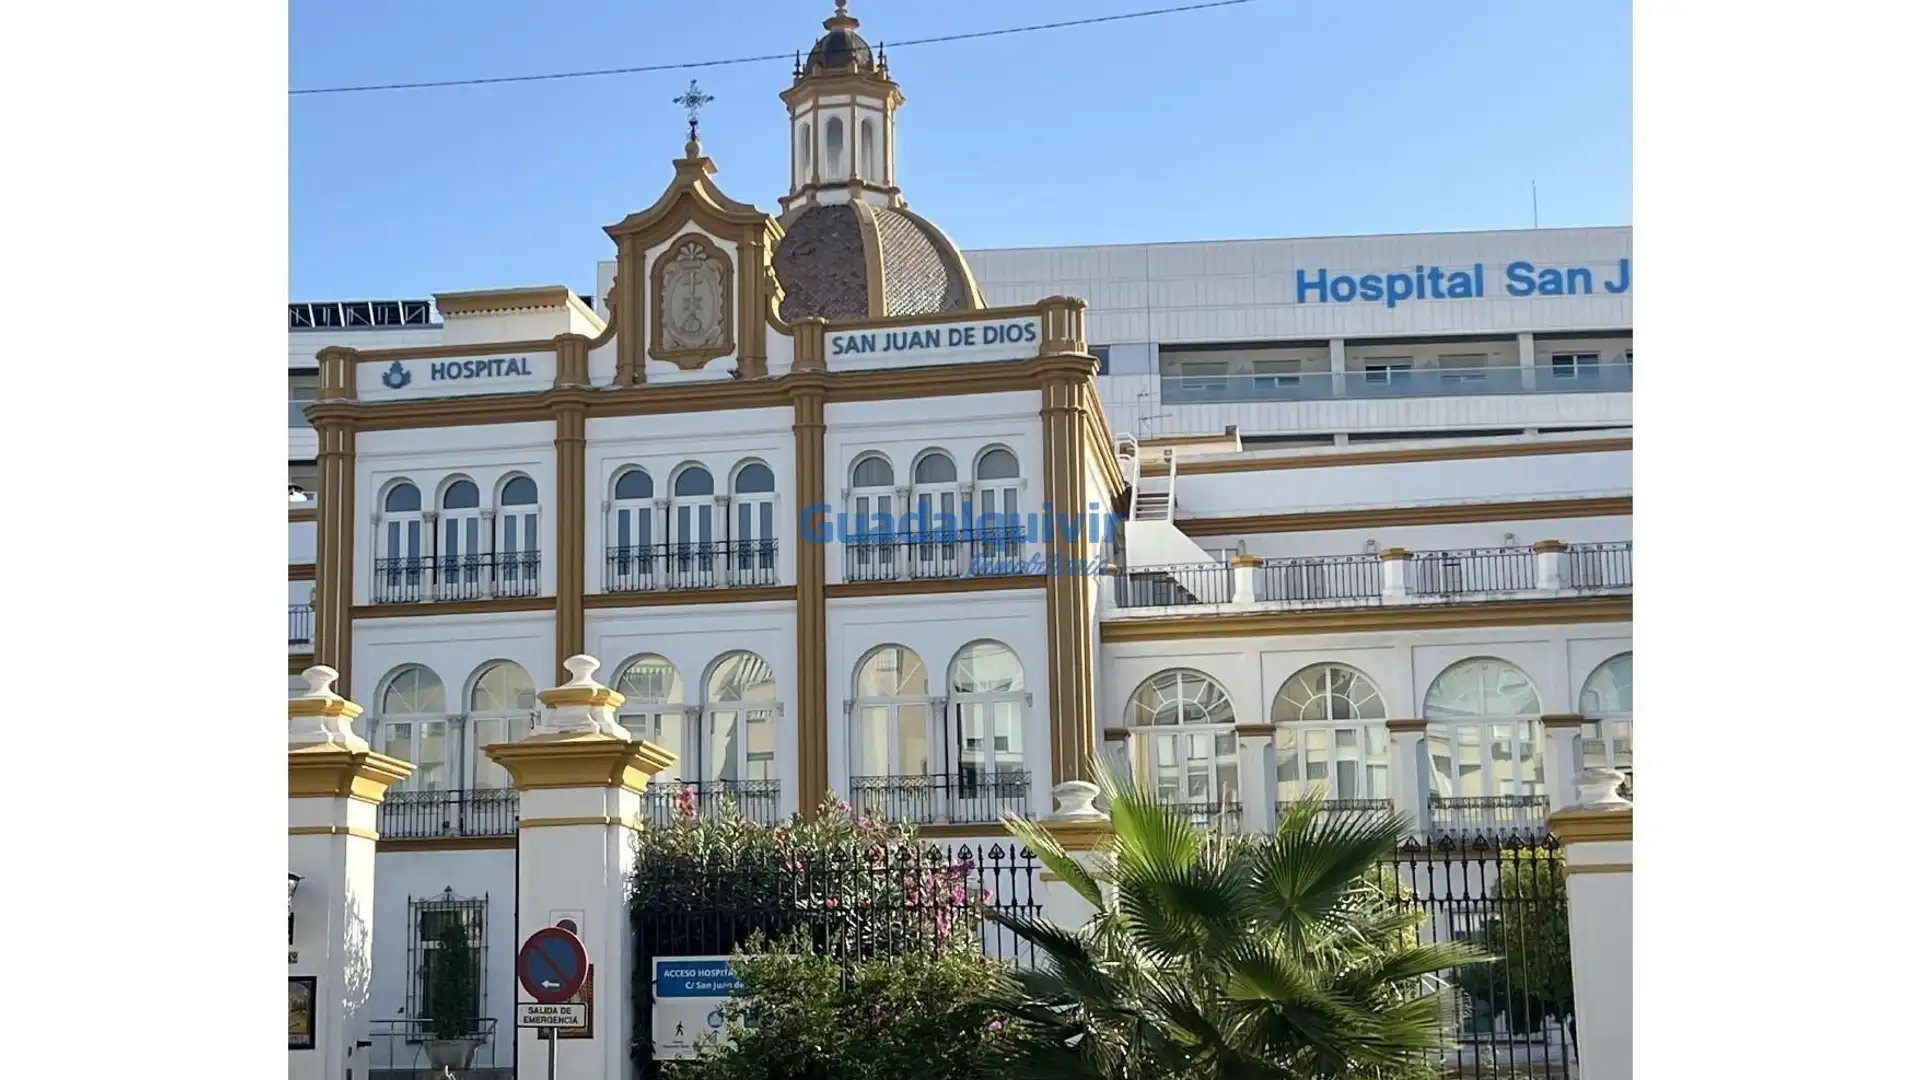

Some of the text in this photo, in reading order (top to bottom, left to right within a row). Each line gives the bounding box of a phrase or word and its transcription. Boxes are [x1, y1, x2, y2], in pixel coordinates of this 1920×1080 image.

[1296, 262, 1483, 308] Hospital
[1505, 261, 1592, 297] San
[832, 322, 1036, 355] SAN JUAN DE DIOS
[430, 357, 532, 381] HOSPITAL
[663, 969, 737, 978] ACCESO HOSPITA
[695, 981, 712, 989] San
[528, 1006, 573, 1015] SALIDA DE
[523, 1015, 579, 1025] EMERGENCIA
